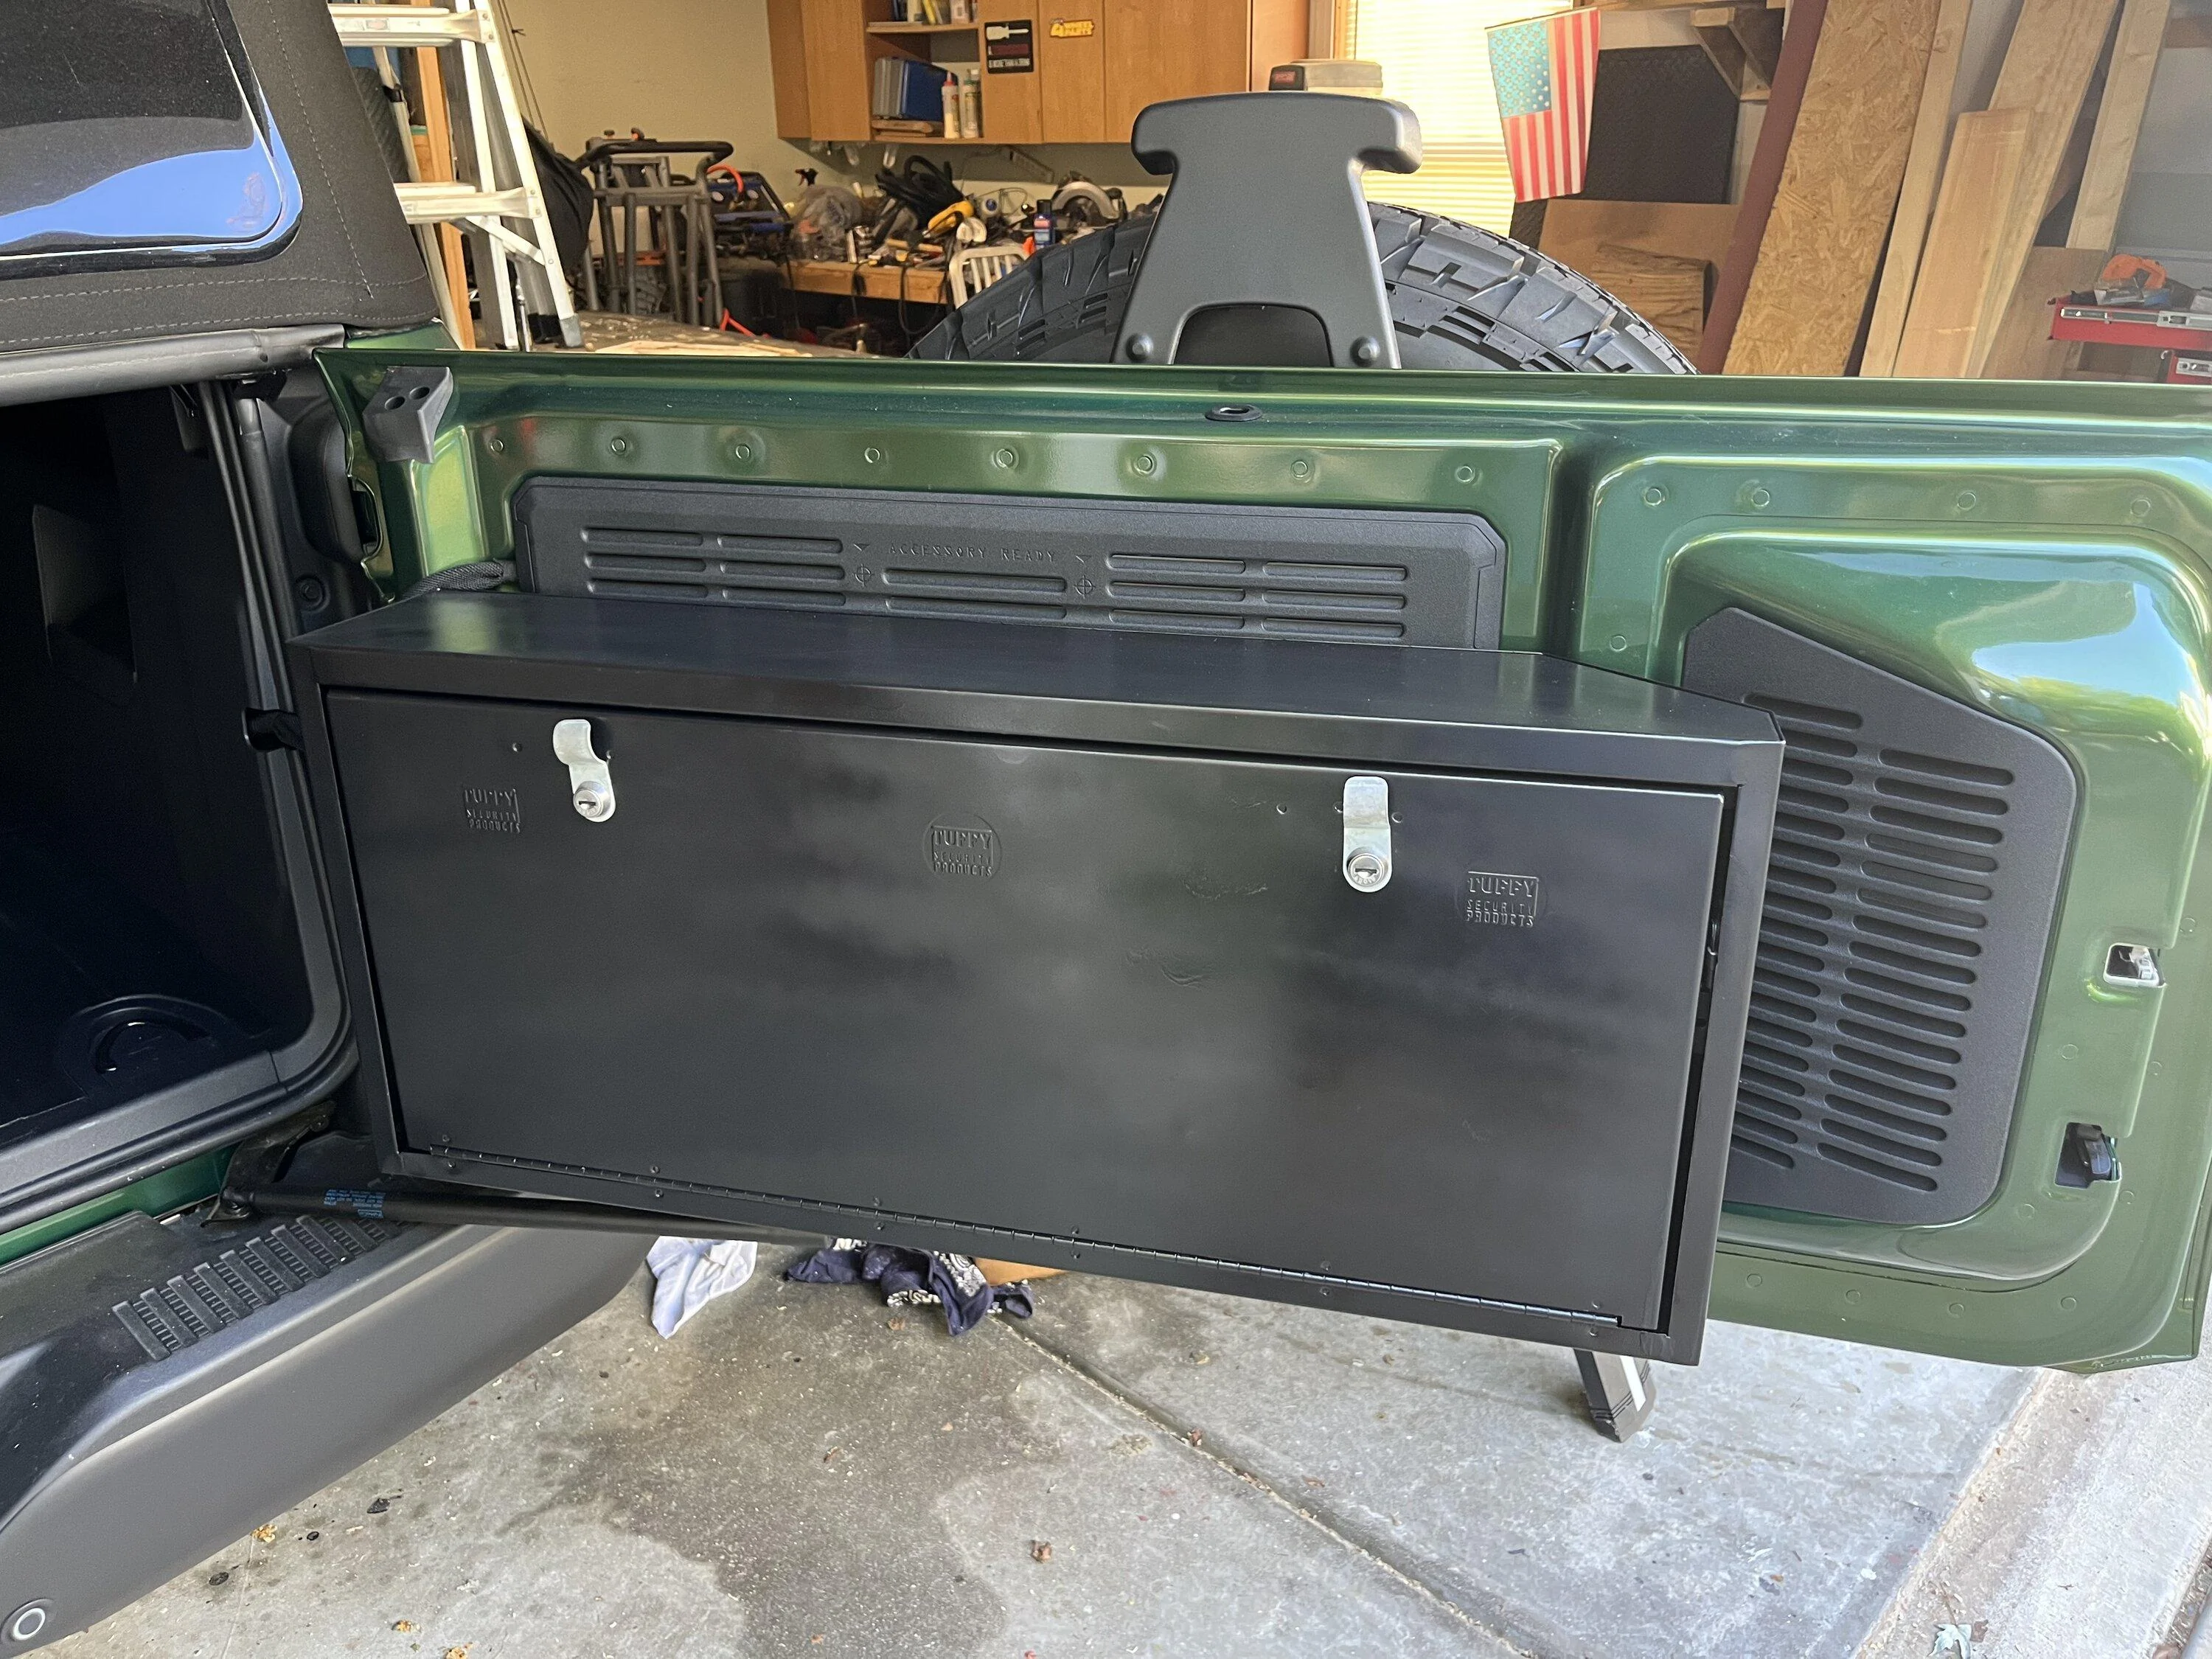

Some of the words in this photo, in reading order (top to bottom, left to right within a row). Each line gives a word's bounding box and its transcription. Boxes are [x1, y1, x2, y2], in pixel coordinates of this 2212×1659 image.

[889, 543, 986, 559] ACCESSORY
[1001, 548, 1055, 563] READY
[933, 830, 990, 849] TUFFY
[934, 861, 992, 877] PRODUCTS
[1467, 877, 1534, 897] TUFFY
[1467, 899, 1534, 916] SECURITY
[1466, 910, 1534, 928] PRODUCTS
